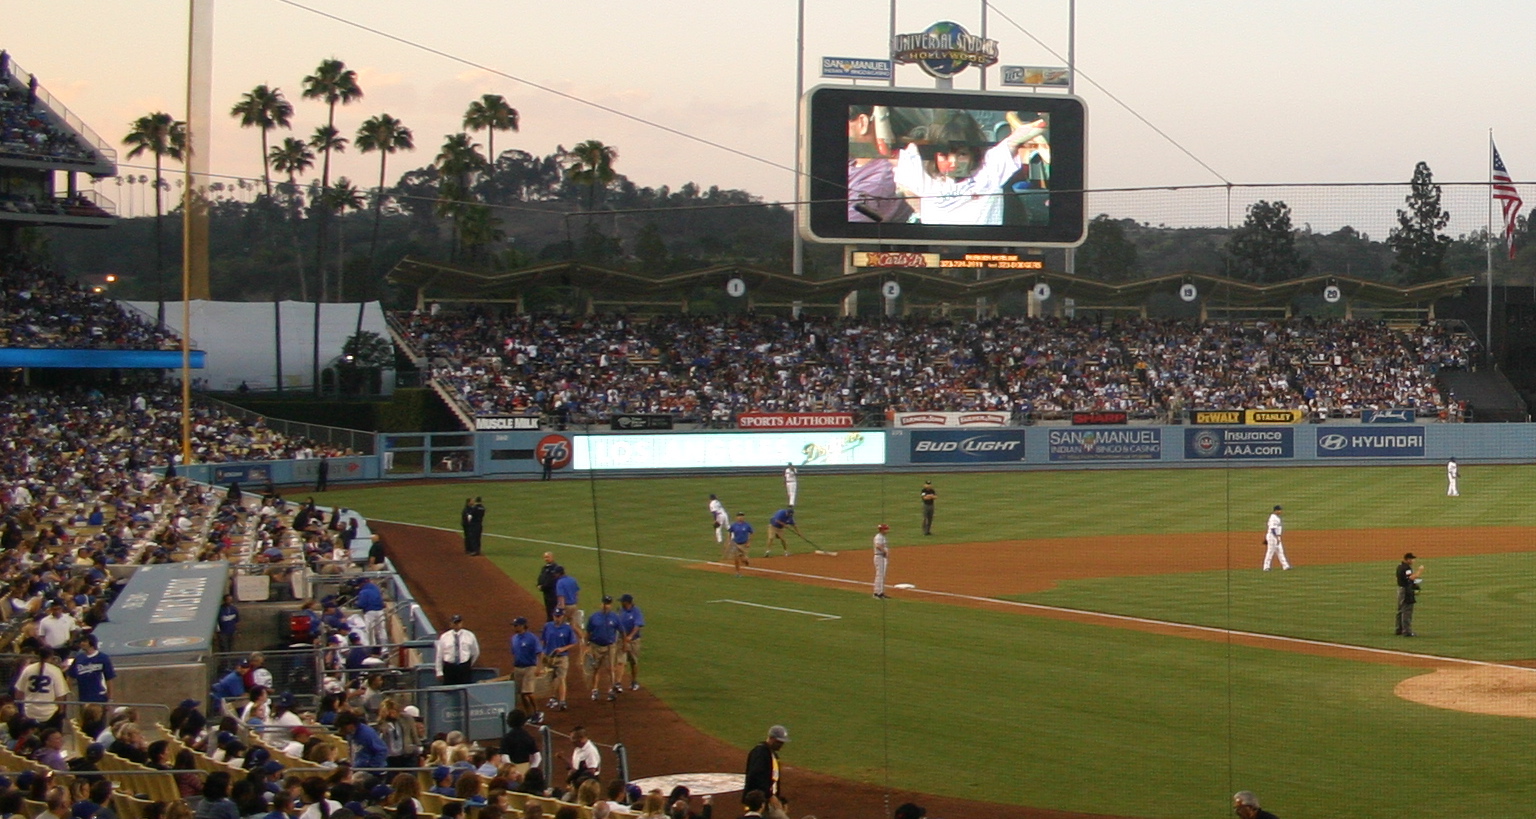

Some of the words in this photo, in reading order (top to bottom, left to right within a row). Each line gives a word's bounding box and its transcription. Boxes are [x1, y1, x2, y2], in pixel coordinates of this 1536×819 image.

[895, 33, 952, 52] UNIVERSAL
[956, 33, 999, 58] STUDIOS
[909, 52, 986, 63] HOLLYWOOD
[824, 59, 843, 69] SAN
[851, 60, 889, 71] MANUEL
[740, 416, 785, 427] SPORTS
[786, 415, 853, 427] AUTHORITY
[1073, 413, 1126, 424] SHARP
[1255, 413, 1292, 422] STANLEY
[476, 418, 514, 429] MUSCLE
[514, 418, 539, 429] MILK
[1050, 431, 1082, 445] SAN
[1096, 430, 1159, 444] MANUEL
[1224, 430, 1282, 440] Insurance
[1352, 435, 1422, 448] HYUNDAI
[541, 440, 569, 462] 76
[1051, 446, 1082, 454] INDIAN
[1097, 445, 1123, 453] BINGO
[1129, 444, 1160, 453] CASINO
[1224, 445, 1282, 455] AAA.com
[28, 675, 52, 694] 32
